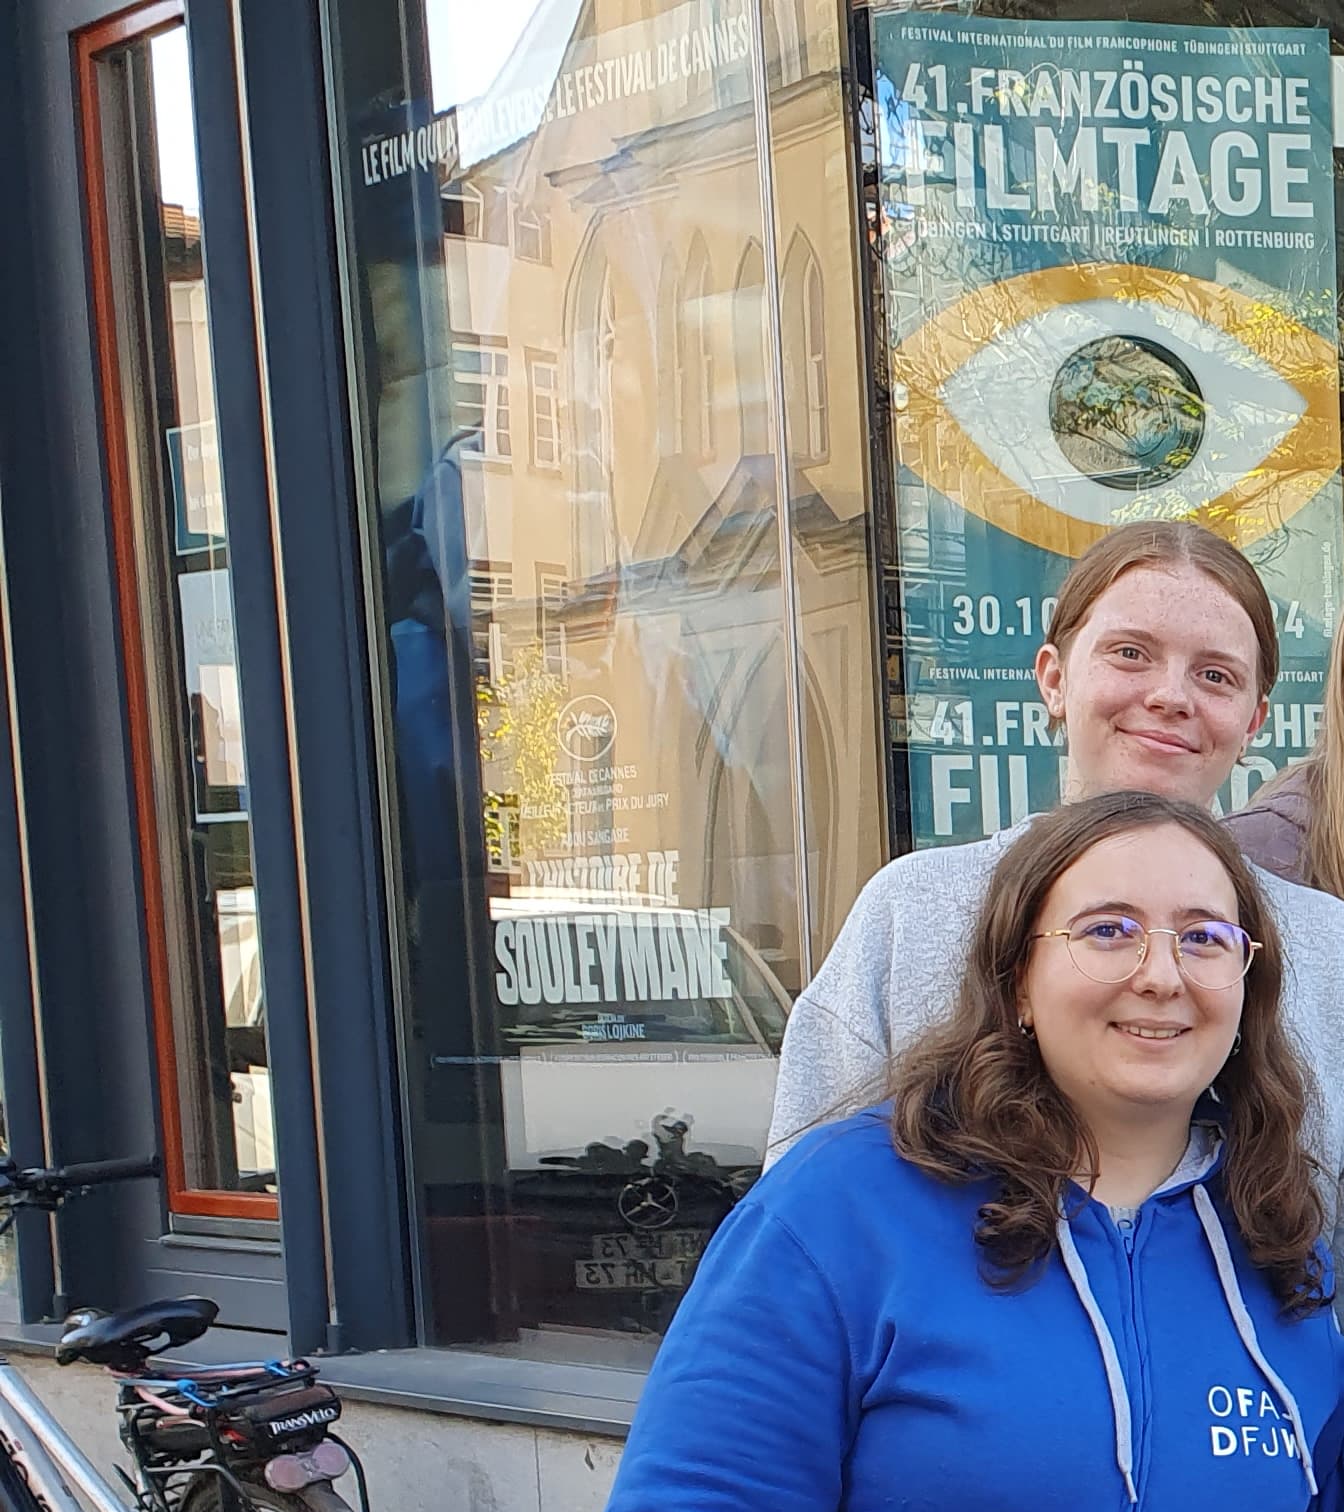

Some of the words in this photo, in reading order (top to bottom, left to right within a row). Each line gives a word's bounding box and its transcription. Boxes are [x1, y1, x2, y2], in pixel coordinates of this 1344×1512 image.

[901, 27, 954, 43] FESTIVAL
[957, 31, 1047, 49] INTERNATIONAL
[1049, 36, 1064, 49] DU
[1067, 36, 1093, 50] FILM
[1096, 36, 1178, 53] FRANCOPHONE
[362, 143, 381, 187] LE
[379, 129, 415, 178] FILM
[574, 50, 657, 111] FESTIVAL
[655, 35, 678, 82] DE
[679, 15, 751, 74] CANNES
[906, 119, 1314, 219] FILMTAGE
[1000, 224, 1089, 245] STUTTGART
[1104, 226, 1199, 247] REUTLINGEN
[1215, 230, 1315, 250] ROTTENBURG
[929, 668, 980, 681] FESTIVAL
[983, 669, 1037, 681] INTERNAT
[645, 792, 670, 808] JURY
[494, 907, 732, 1005] SOULEYMANE
